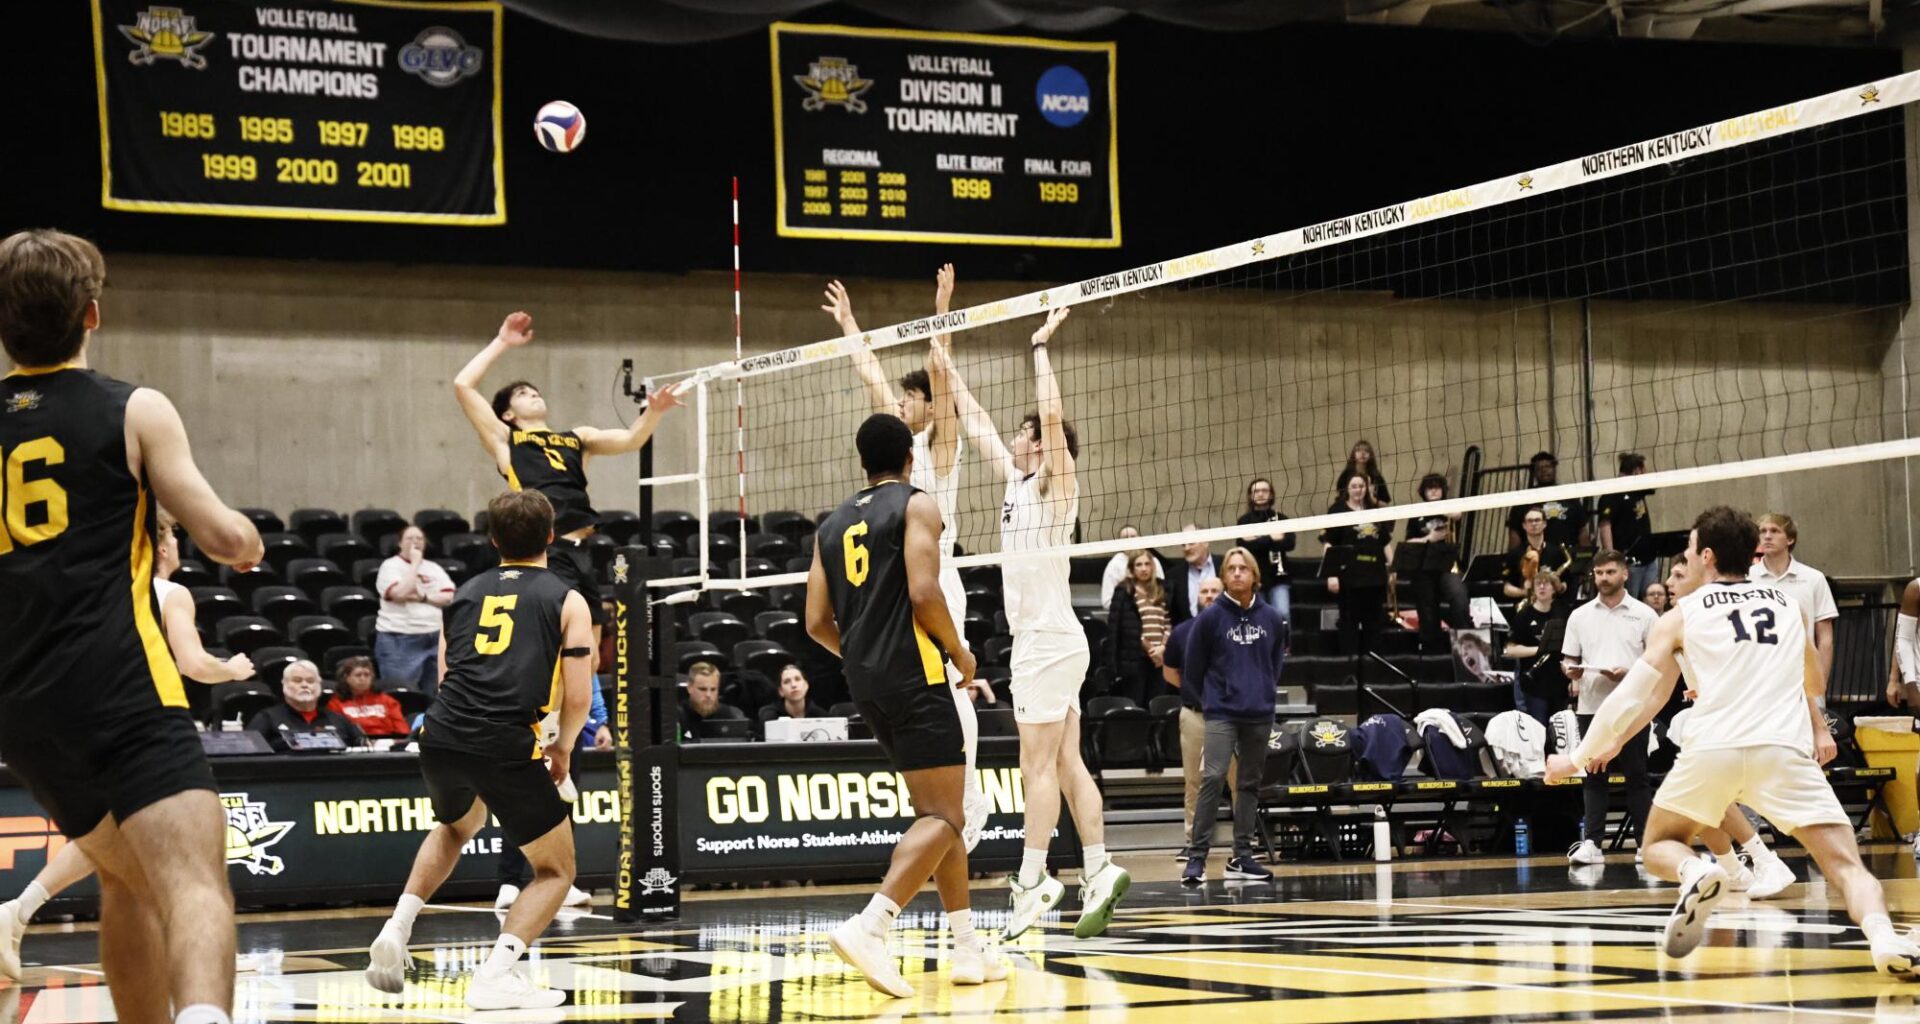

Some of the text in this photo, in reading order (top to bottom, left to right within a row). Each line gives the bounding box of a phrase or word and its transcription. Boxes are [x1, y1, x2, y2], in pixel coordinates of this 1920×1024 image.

[255, 7, 358, 33] VOLLEYBALL
[226, 32, 388, 68] TOURNAMENT
[907, 54, 994, 76] VOLLEYBALL
[238, 65, 379, 99] CHAMPIONS
[900, 79, 1003, 107] DIVISION II
[1041, 94, 1090, 113] NCAA
[159, 111, 445, 152] 1985 1995 1997 1998
[884, 107, 1019, 137] TOURNAMENT
[1581, 105, 1800, 177] NORTHERN KENTUCKY VOLLEYBALL
[202, 153, 412, 188] 1999 2000 2001
[822, 148, 881, 167] REGIONAL
[936, 153, 1004, 173] ELITE EIGHT
[1024, 158, 1092, 176] FINAL FOUR
[951, 177, 992, 199] 1998
[1039, 181, 1079, 203] 1999
[1302, 217, 1351, 245] NORTHERN
[1354, 204, 1405, 233] KENTUCKY
[1080, 275, 1121, 298] NORTHERN
[1122, 263, 1163, 288] KENTUCKY
[896, 321, 931, 339] NORTHERN
[932, 312, 967, 331] KENTUCKY
[843, 519, 870, 587] 6
[1702, 588, 1787, 609] QUEENS
[474, 594, 518, 655] 5
[1727, 607, 1779, 645] 12
[616, 600, 633, 909] NORTHERN KENTUCKY
[650, 766, 665, 857] sports imports
[705, 775, 770, 824] GO
[696, 837, 755, 854] Support
[757, 834, 800, 849] Norse
[801, 830, 905, 848] Student-Athlet
